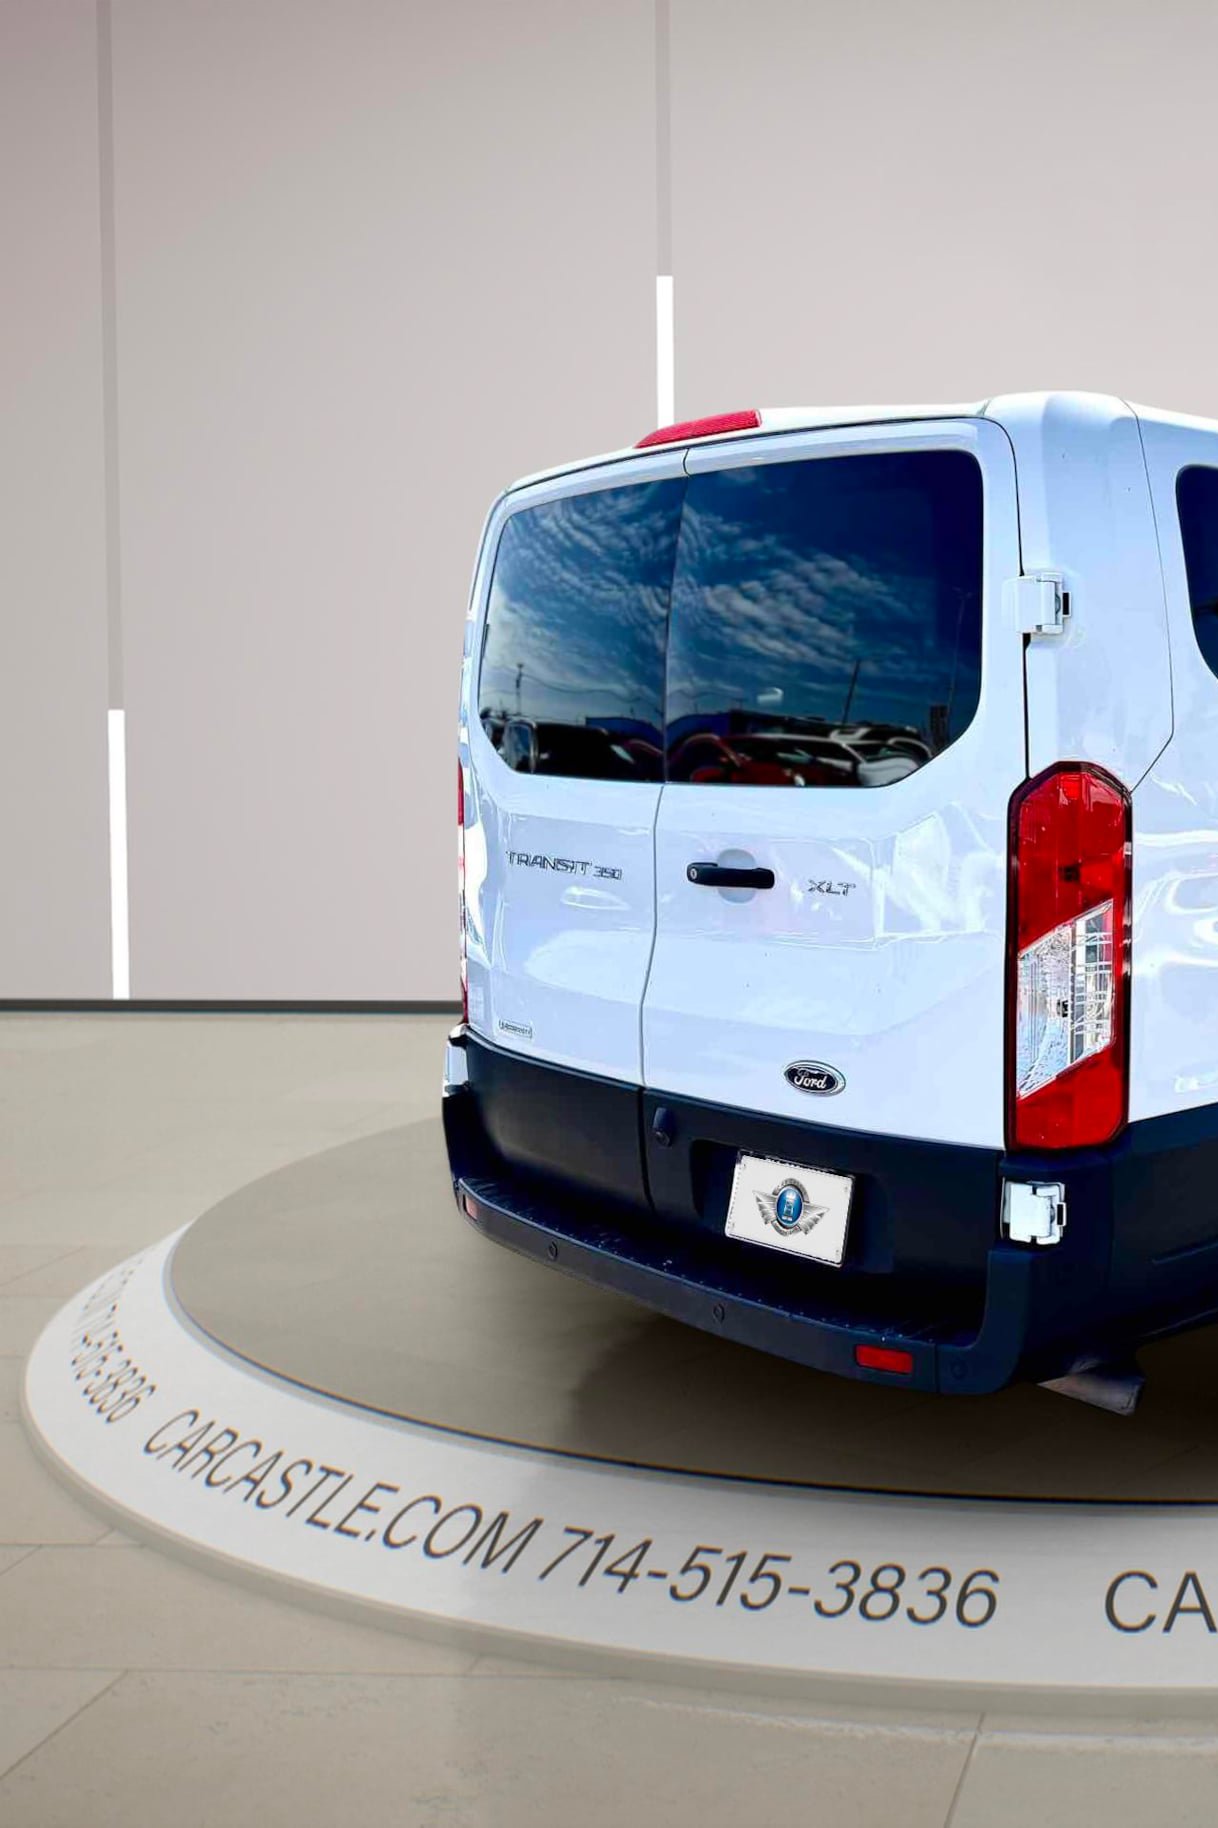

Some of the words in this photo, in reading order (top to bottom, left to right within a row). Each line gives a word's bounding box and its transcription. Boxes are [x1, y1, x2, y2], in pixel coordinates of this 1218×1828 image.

[505, 851, 592, 876] TRANSIT
[592, 865, 623, 881] 350
[808, 879, 856, 897] XLT
[69, 1303, 157, 1424] -515-3836
[143, 1409, 543, 1574] CARCASTLE.COM
[538, 1526, 1001, 1629] 714-515-3836
